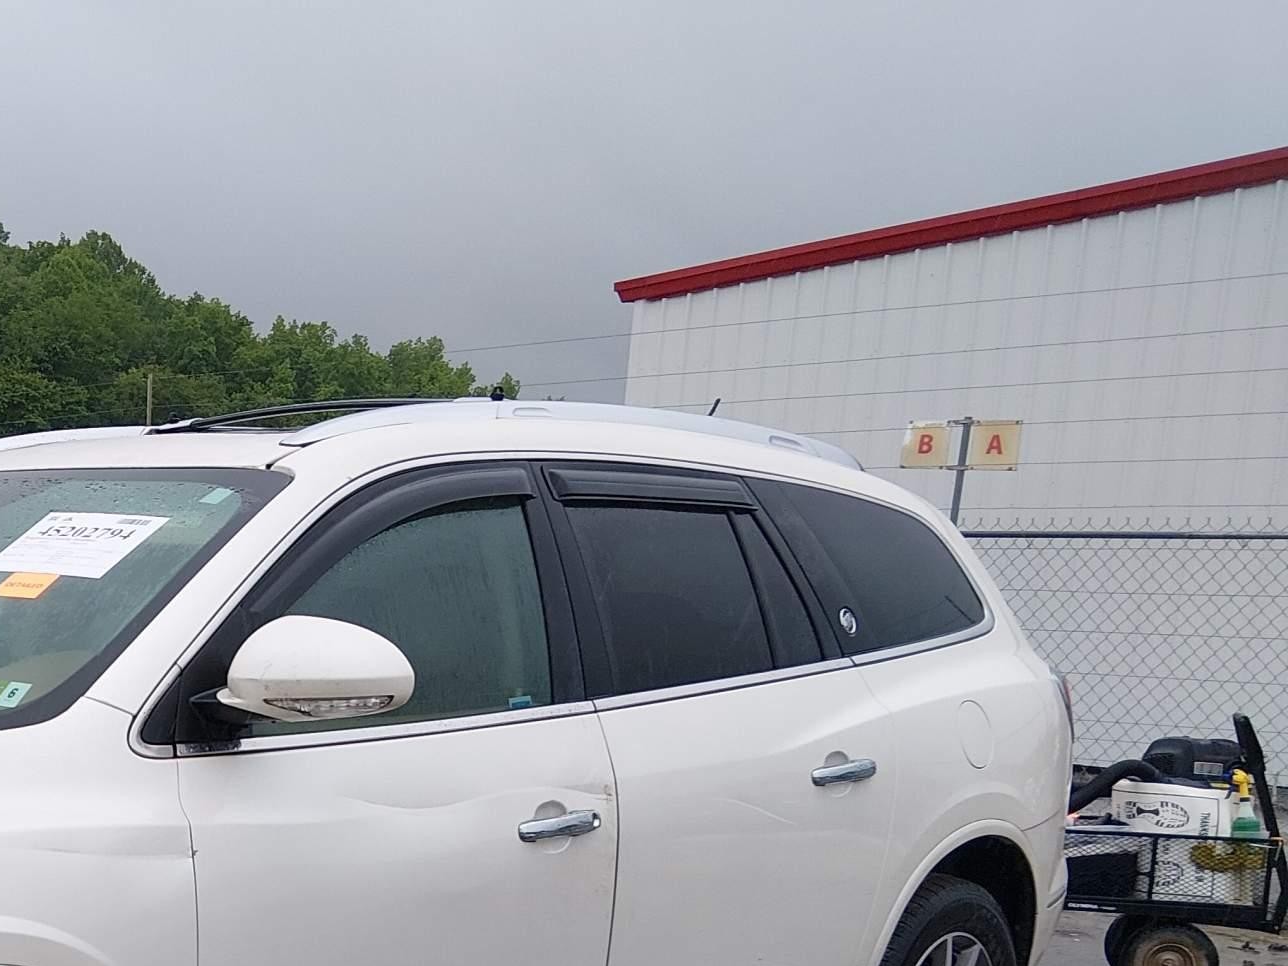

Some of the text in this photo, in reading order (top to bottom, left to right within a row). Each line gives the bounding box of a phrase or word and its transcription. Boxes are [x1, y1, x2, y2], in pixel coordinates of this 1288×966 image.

[918, 434, 934, 454] B
[986, 434, 1003, 455] A
[38, 526, 137, 540] 45202794
[7, 687, 19, 698] 6
